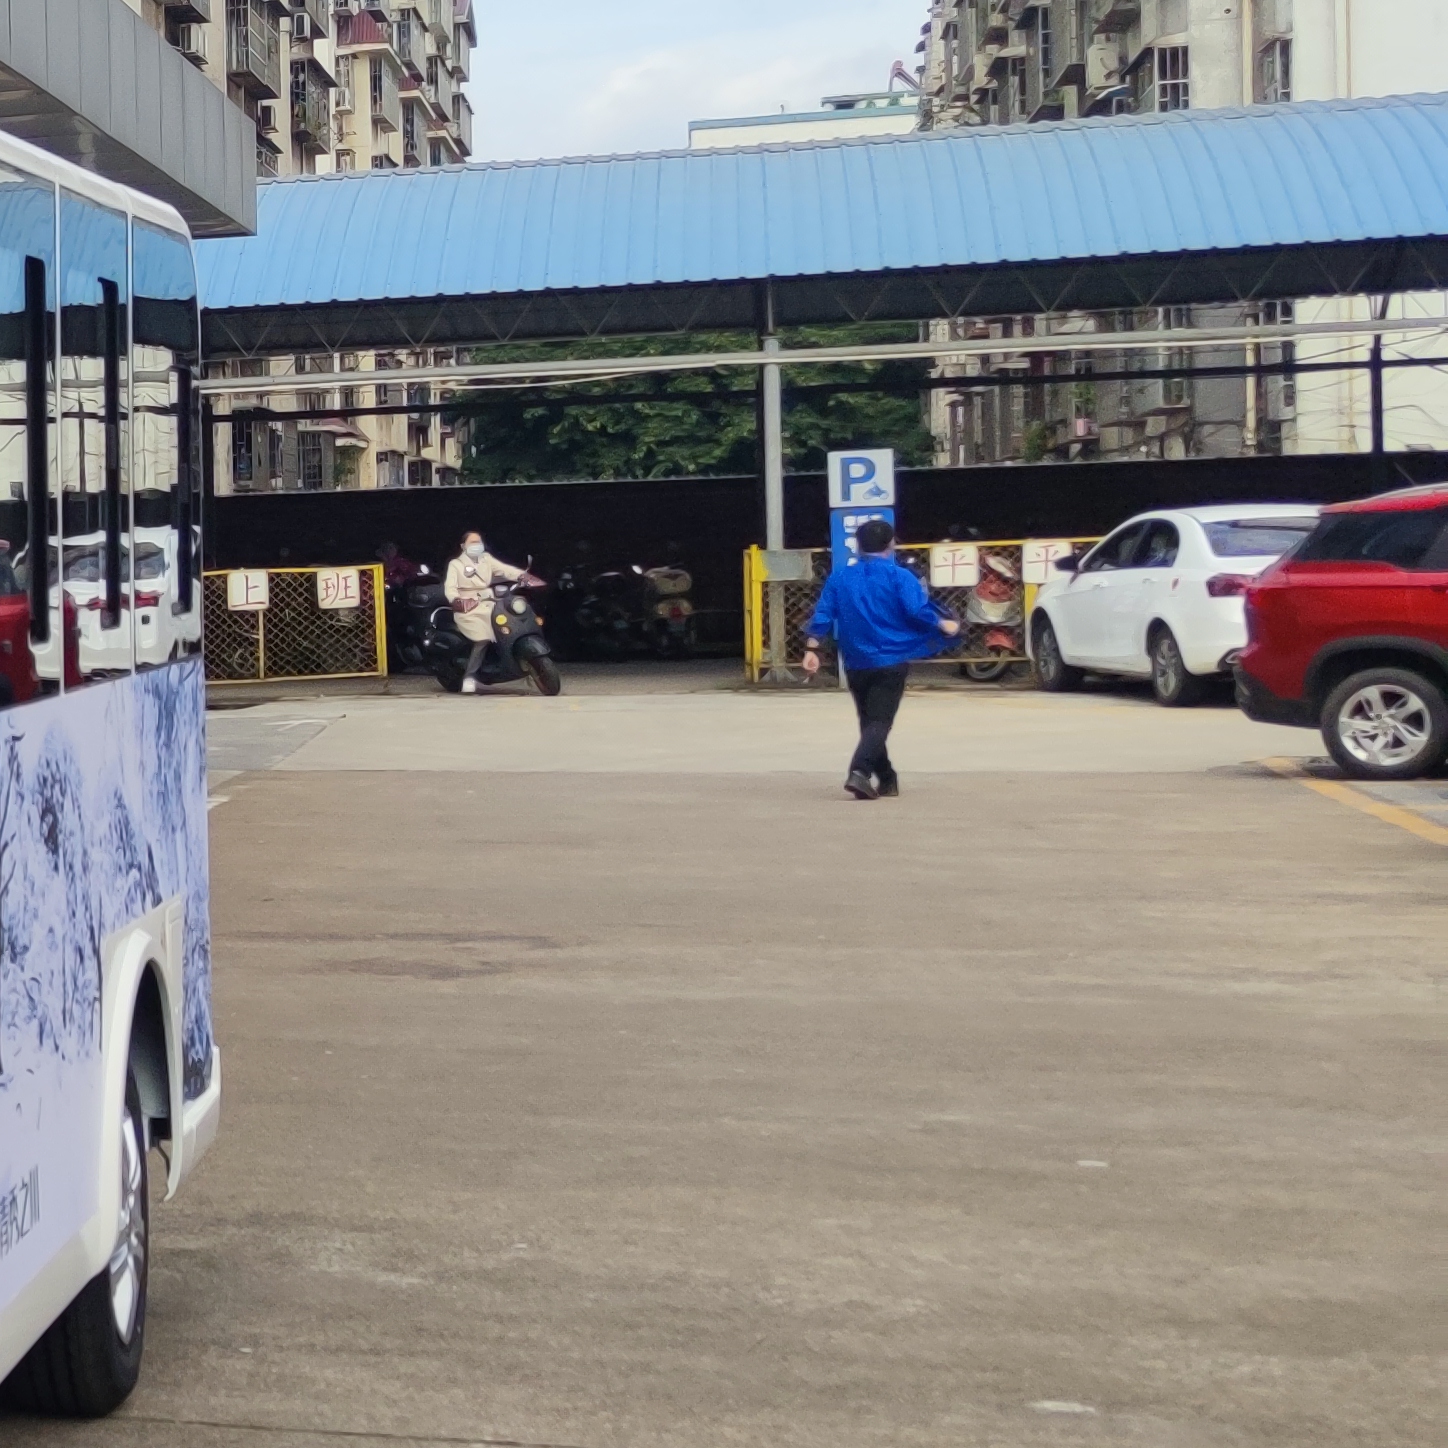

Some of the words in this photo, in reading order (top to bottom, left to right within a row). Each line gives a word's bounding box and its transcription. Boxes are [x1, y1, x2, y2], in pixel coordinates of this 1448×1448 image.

[840, 457, 876, 501] P
[934, 548, 974, 583] 平
[1026, 544, 1061, 580] 平
[231, 574, 266, 607] 上
[320, 571, 357, 605] 班
